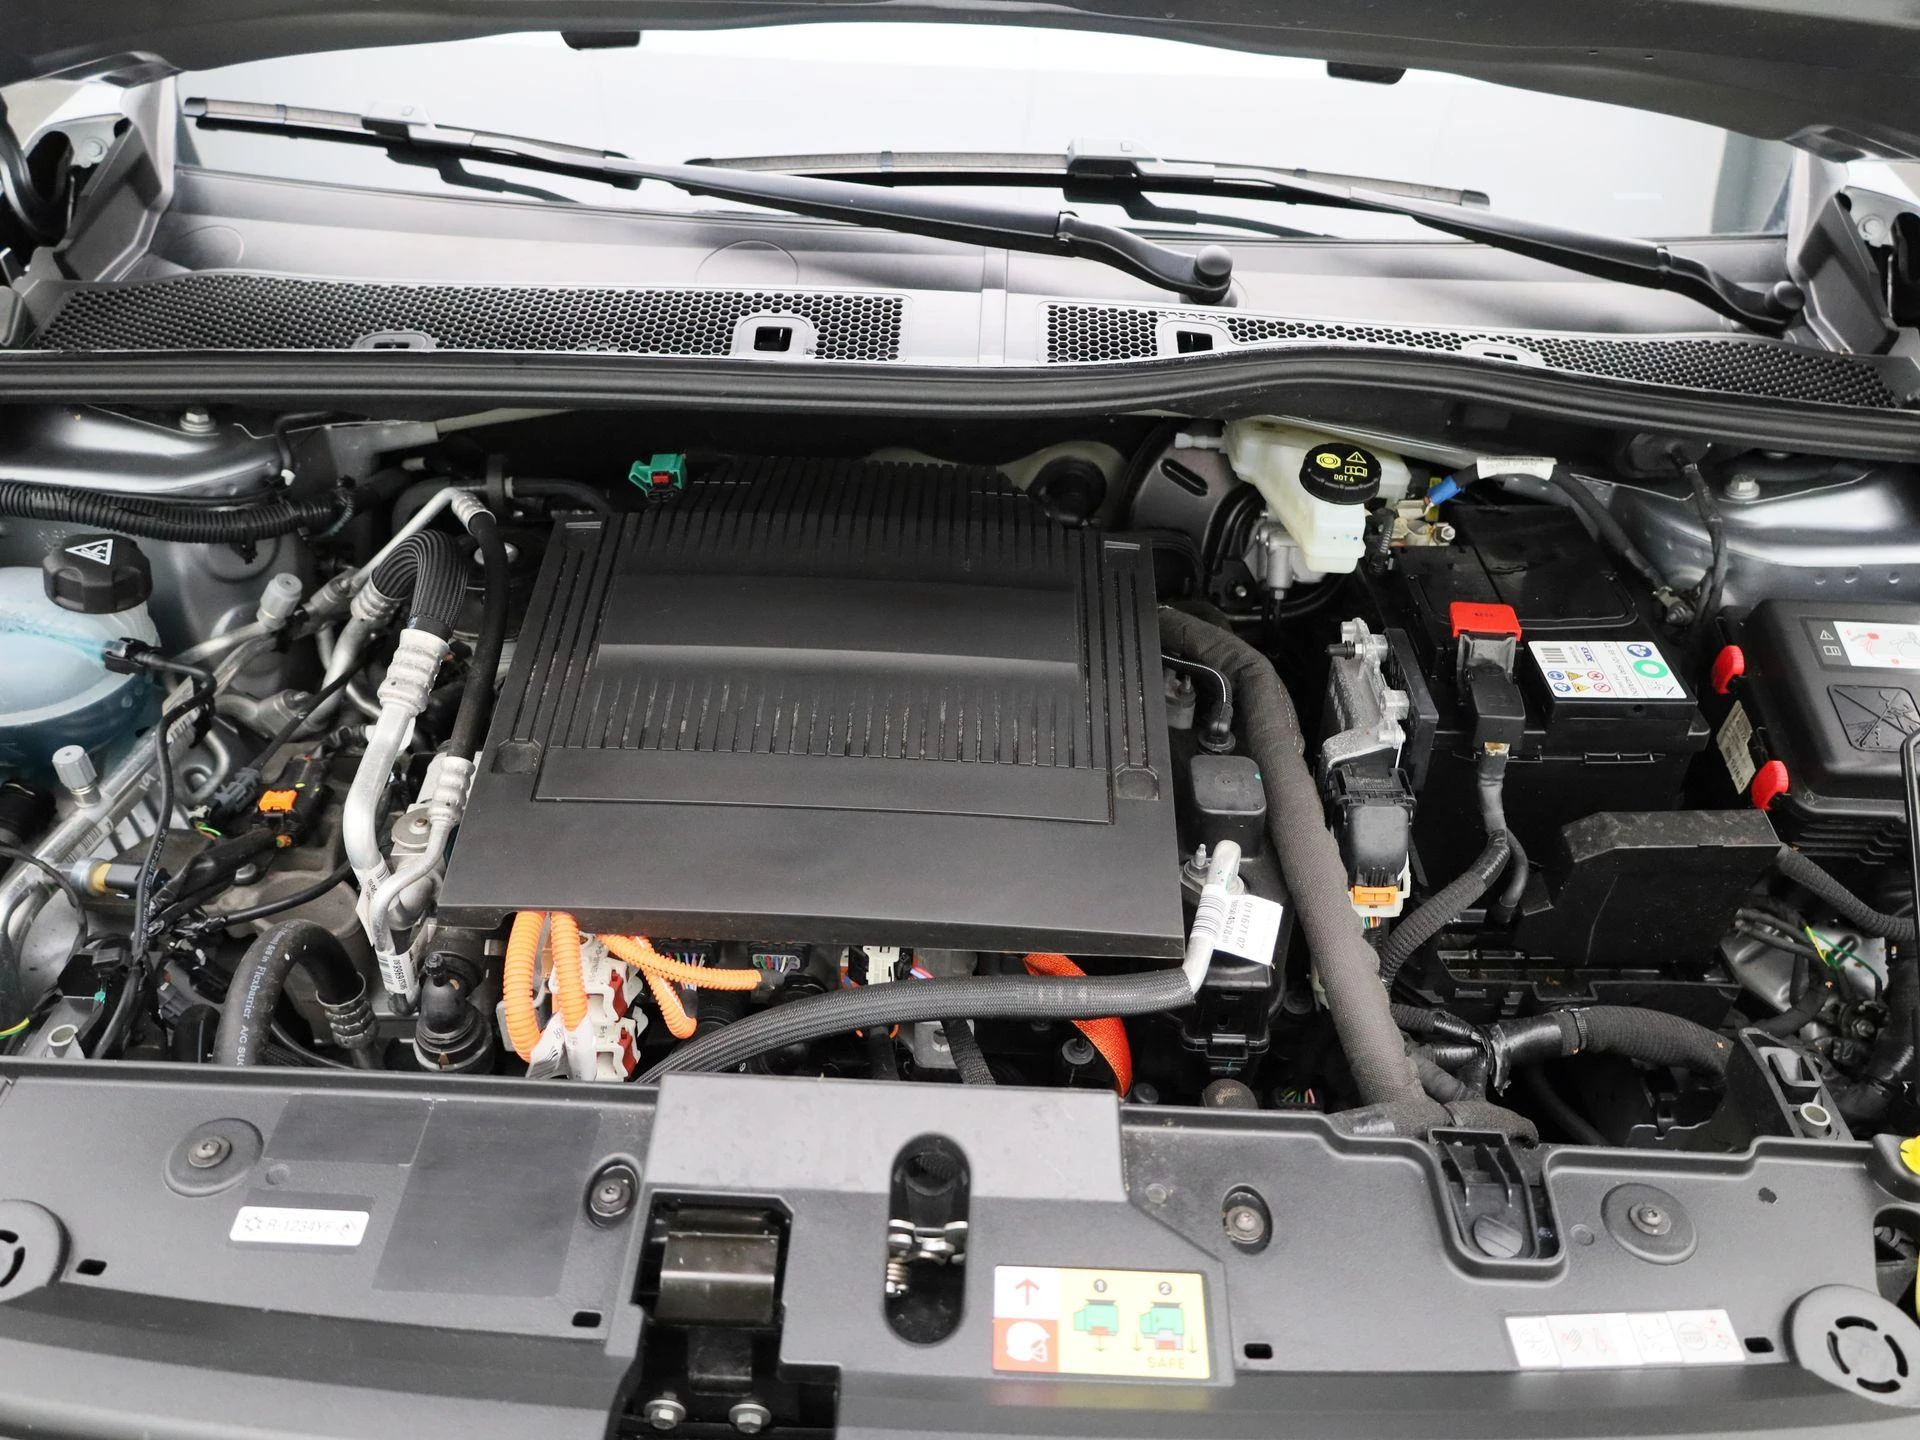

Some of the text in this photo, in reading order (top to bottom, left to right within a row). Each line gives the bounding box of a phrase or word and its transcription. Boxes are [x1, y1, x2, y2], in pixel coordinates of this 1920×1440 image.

[1334, 473, 1348, 482] DOT
[243, 965, 267, 1019] Flexbarrier
[239, 1025, 249, 1043] A/C
[1148, 1356, 1185, 1370] SAFE
